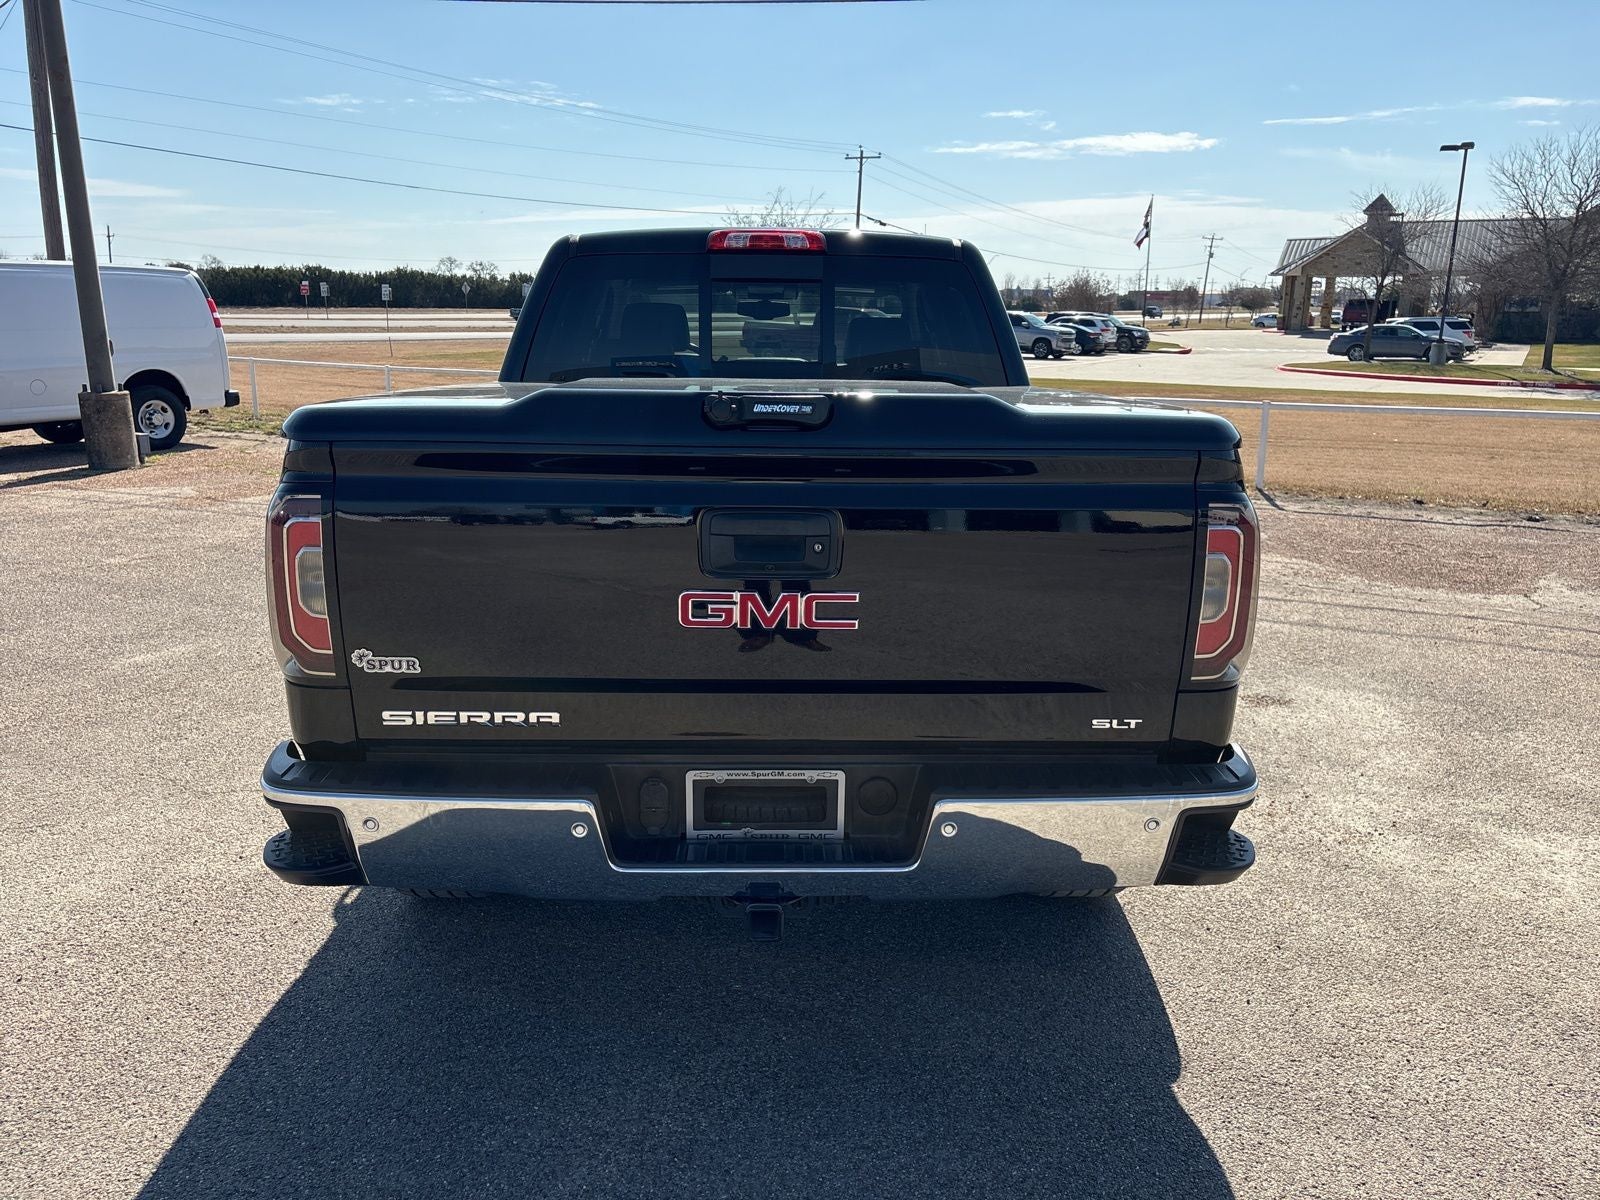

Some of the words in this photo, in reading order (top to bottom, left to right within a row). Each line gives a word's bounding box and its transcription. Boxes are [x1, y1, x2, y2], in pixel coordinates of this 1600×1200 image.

[678, 591, 861, 630] GMC
[366, 659, 418, 671] SPUR
[381, 710, 562, 727] SIERRA
[1091, 719, 1143, 729] SLT
[696, 833, 733, 841] GMC
